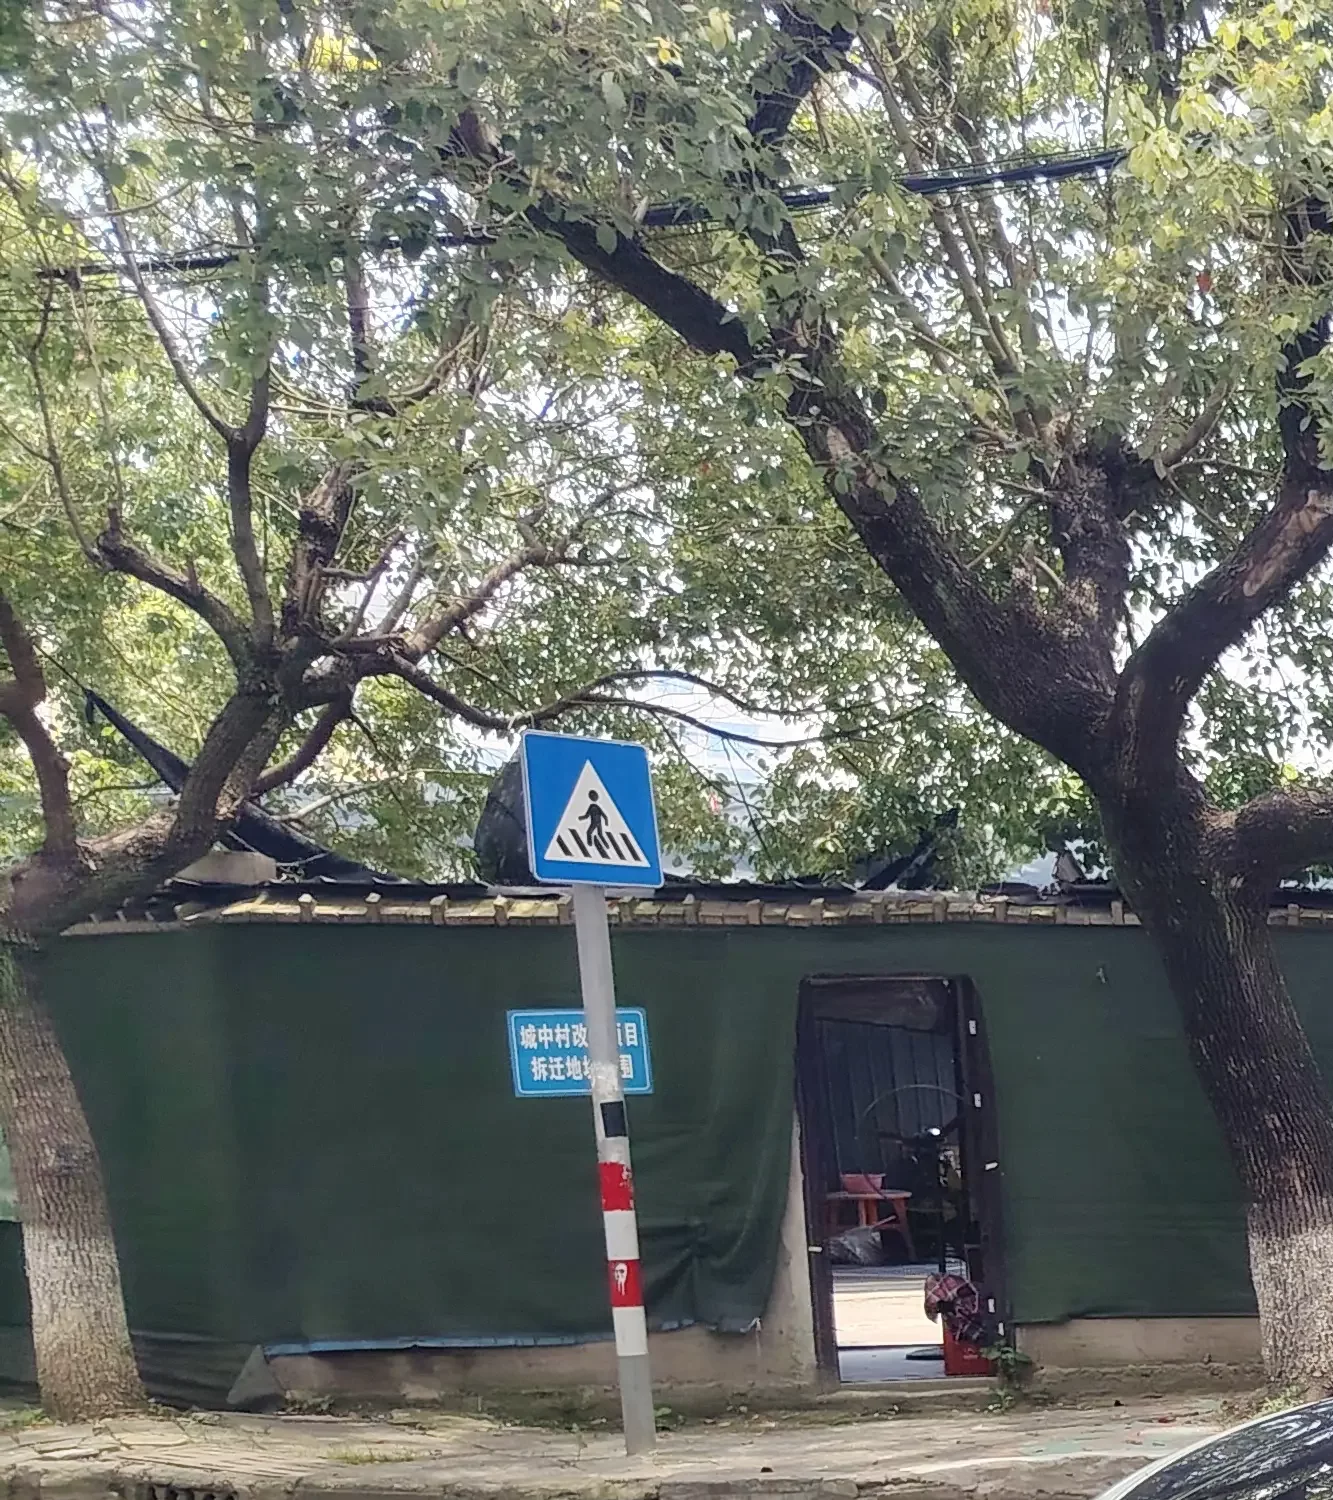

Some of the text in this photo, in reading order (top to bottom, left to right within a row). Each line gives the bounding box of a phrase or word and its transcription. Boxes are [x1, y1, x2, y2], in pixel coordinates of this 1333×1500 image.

[520, 1022, 639, 1050] 城中村改目
